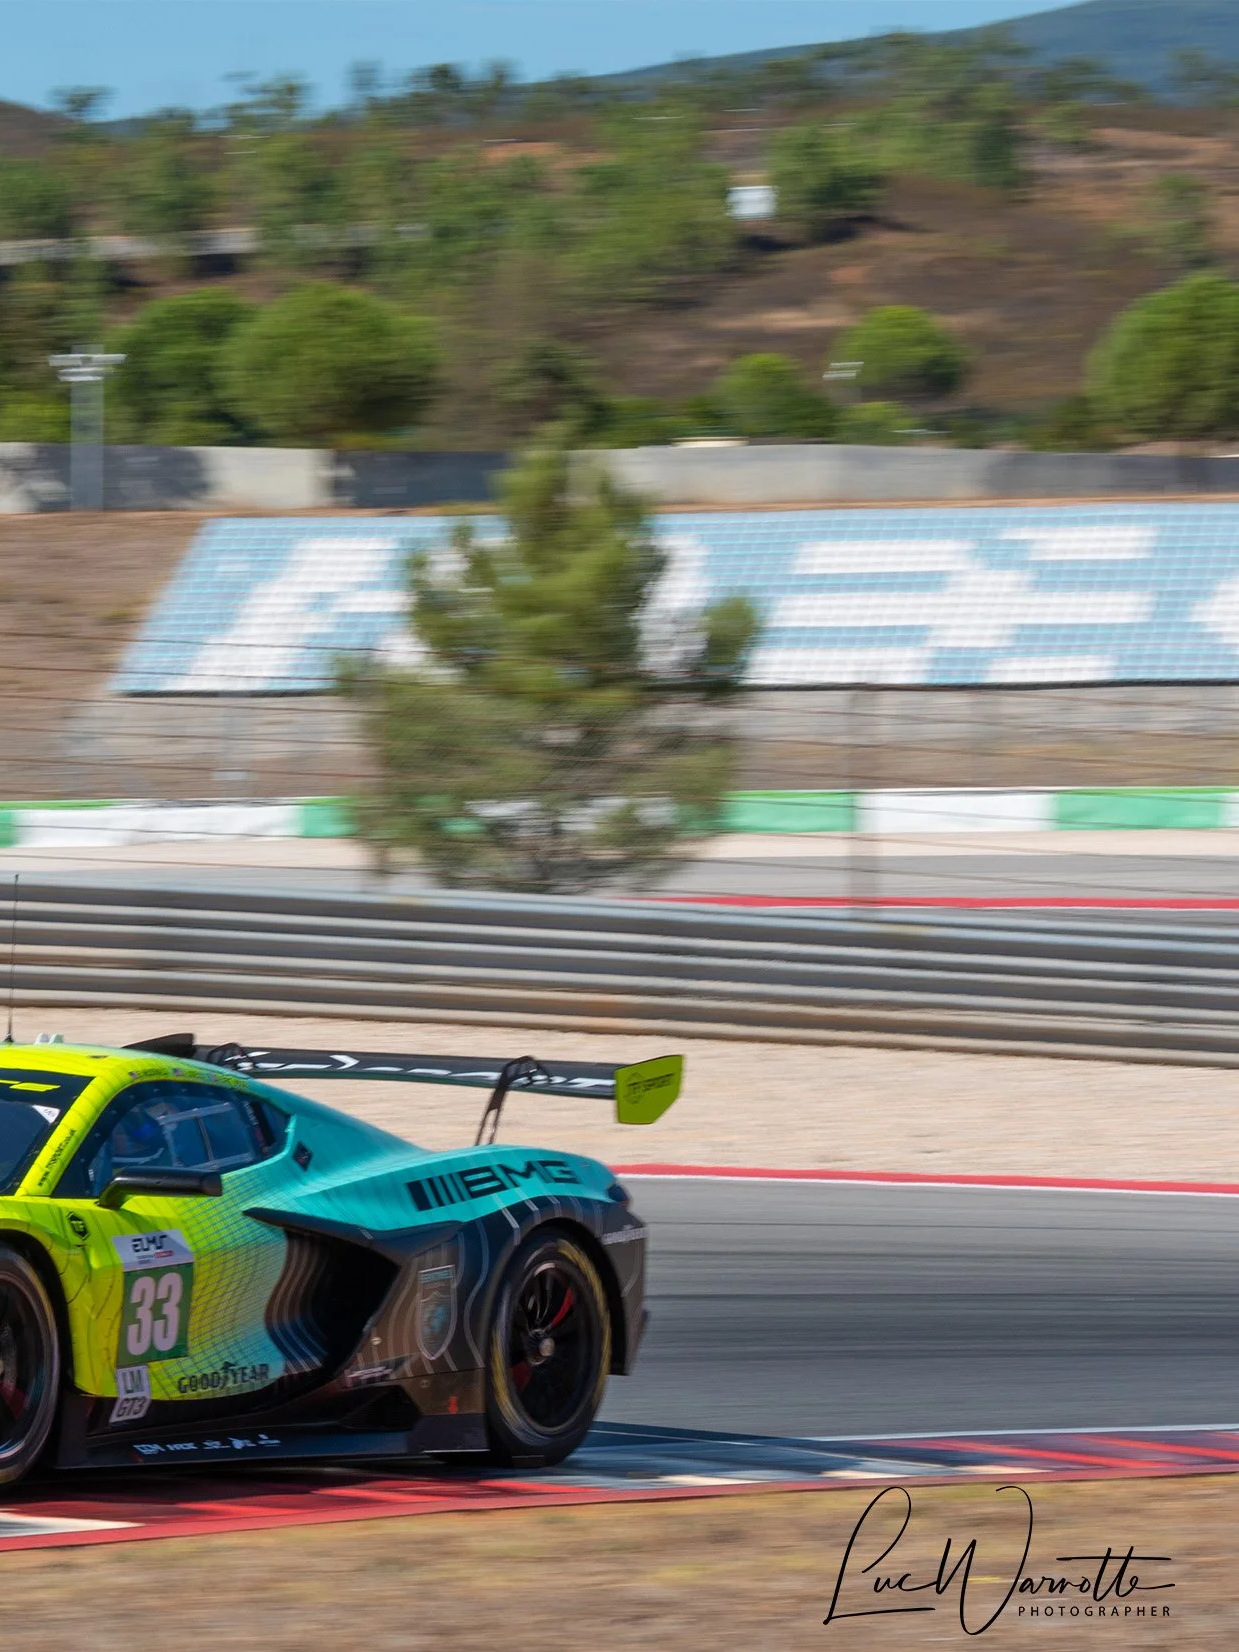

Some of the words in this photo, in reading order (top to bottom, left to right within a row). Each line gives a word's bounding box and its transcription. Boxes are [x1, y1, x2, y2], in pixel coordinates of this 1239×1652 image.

[126, 1271, 183, 1356] 33
[122, 1368, 146, 1394] LM
[115, 1396, 147, 1418] GT3
